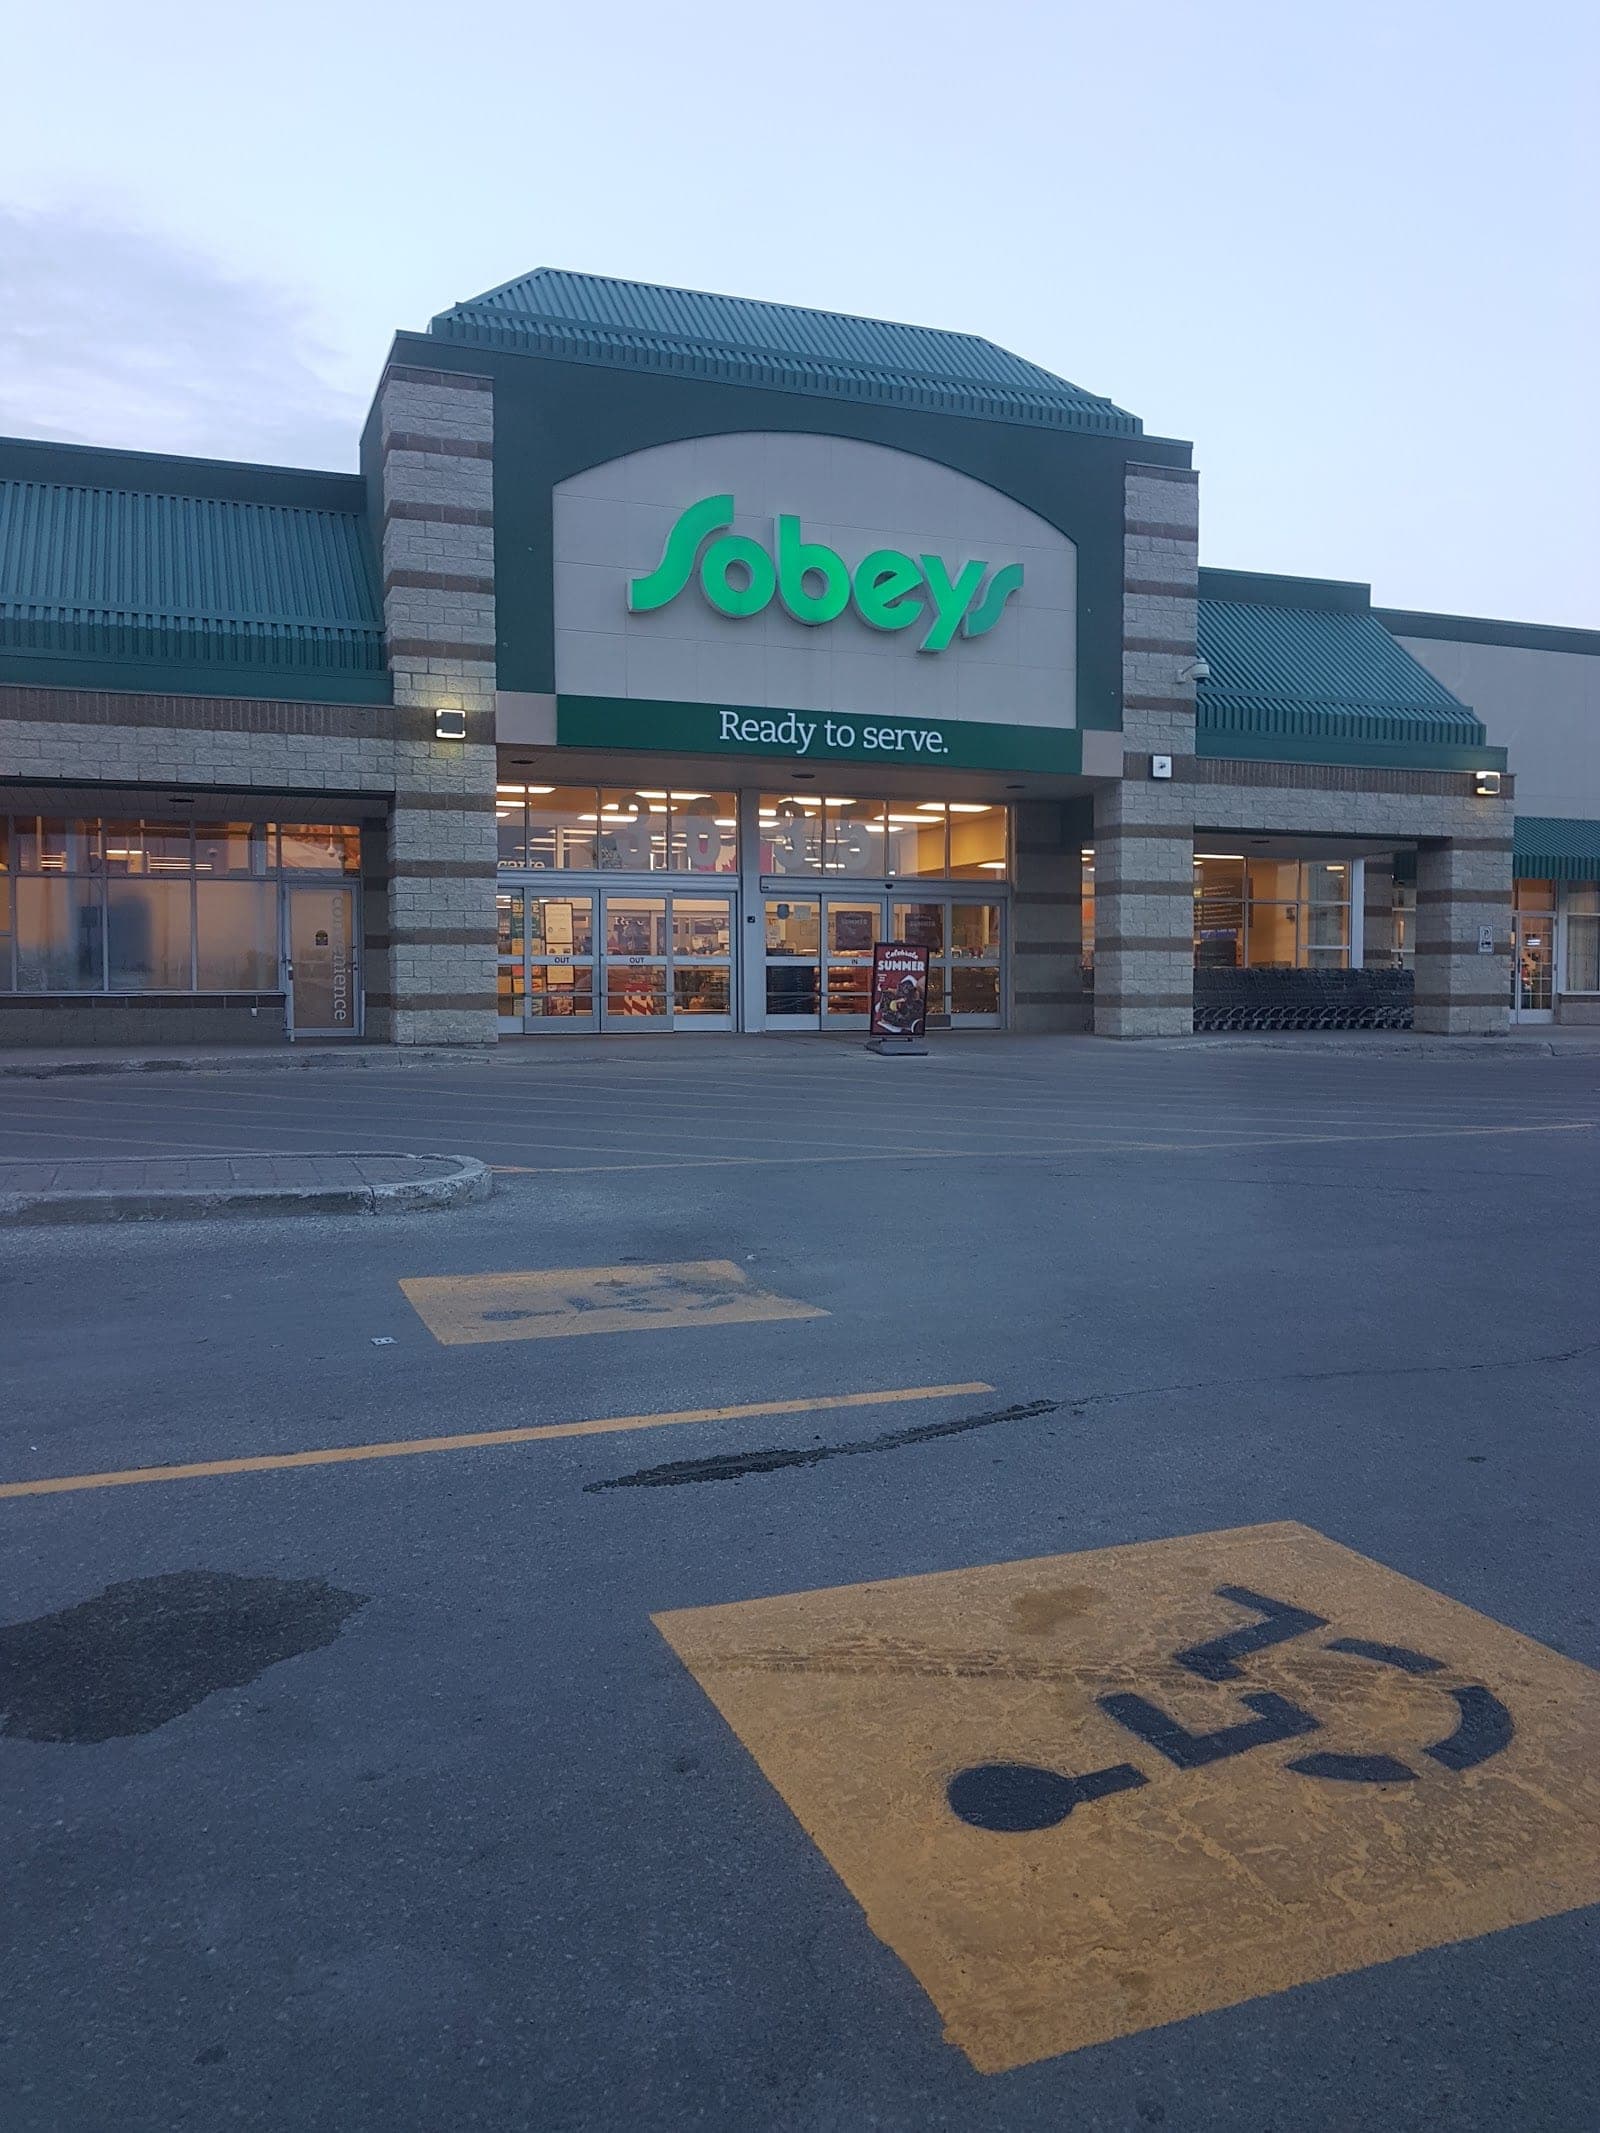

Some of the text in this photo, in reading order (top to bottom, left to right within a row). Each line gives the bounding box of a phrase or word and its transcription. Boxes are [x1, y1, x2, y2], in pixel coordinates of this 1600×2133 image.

[627, 494, 1024, 653] Sobeys
[719, 711, 949, 754] Ready to serve.
[878, 960, 925, 971] SUMMER
